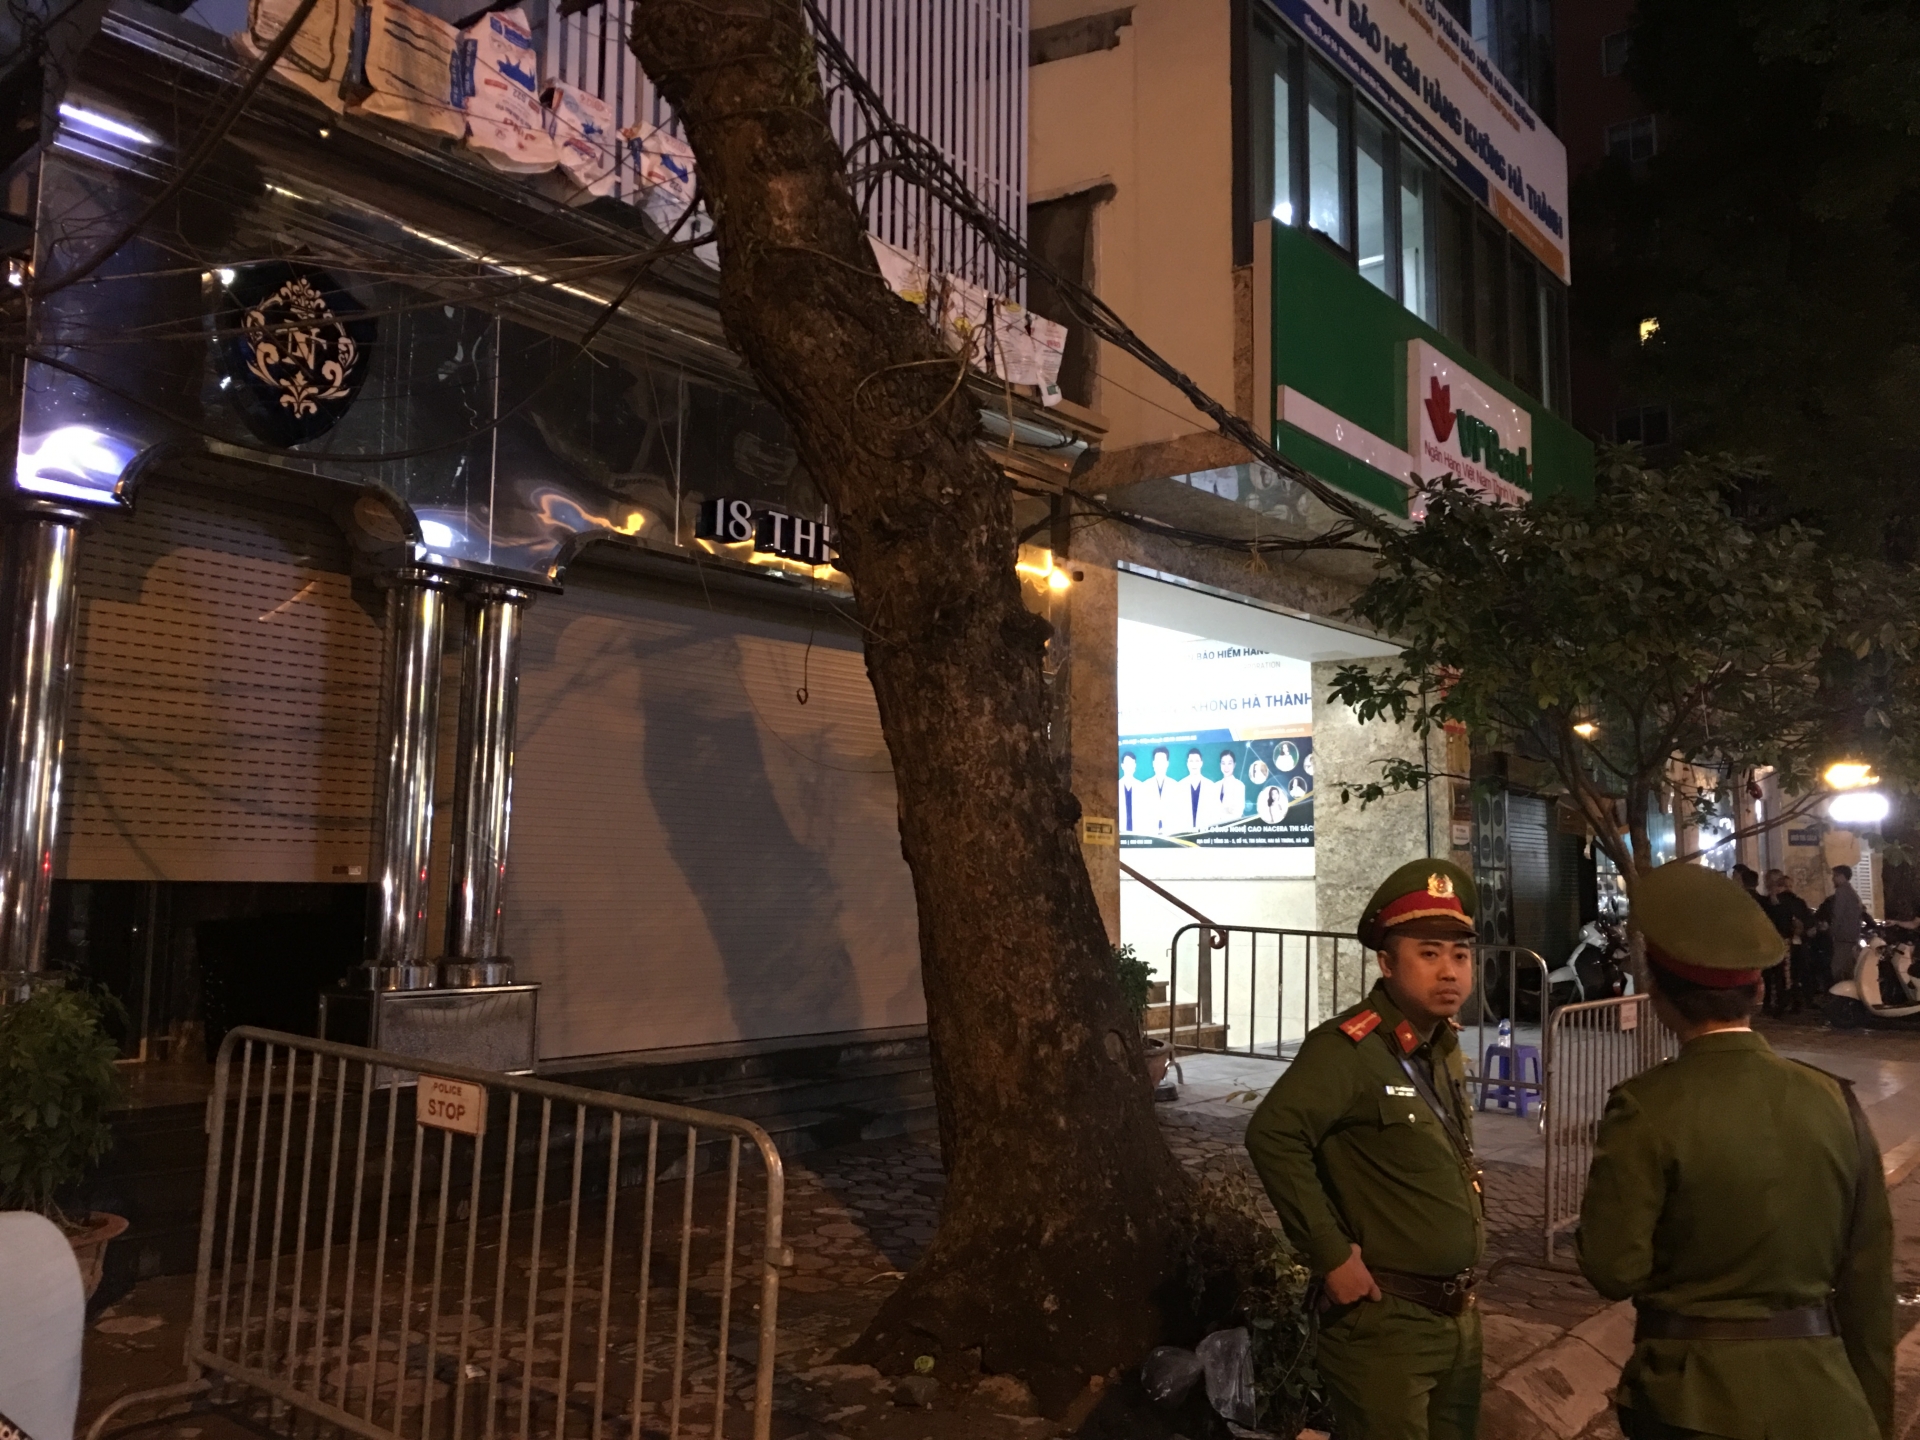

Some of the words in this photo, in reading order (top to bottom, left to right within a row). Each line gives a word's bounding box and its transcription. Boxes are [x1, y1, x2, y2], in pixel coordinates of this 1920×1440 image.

[1348, 0, 1381, 54] BẢO
[1384, 35, 1420, 96] HIỂM
[1423, 75, 1462, 136] HÀNG
[1464, 118, 1507, 181] KHÔNG
[1507, 163, 1525, 202] HÀ
[1526, 183, 1564, 239] THÀNH
[1424, 440, 1443, 463] Ngân
[1476, 469, 1492, 488] Nam
[716, 498, 752, 541] 18
[1242, 694, 1261, 709] HÀ
[1247, 825, 1261, 833] CAO
[433, 1082, 462, 1096] POLICE
[428, 1098, 465, 1121] STOP
